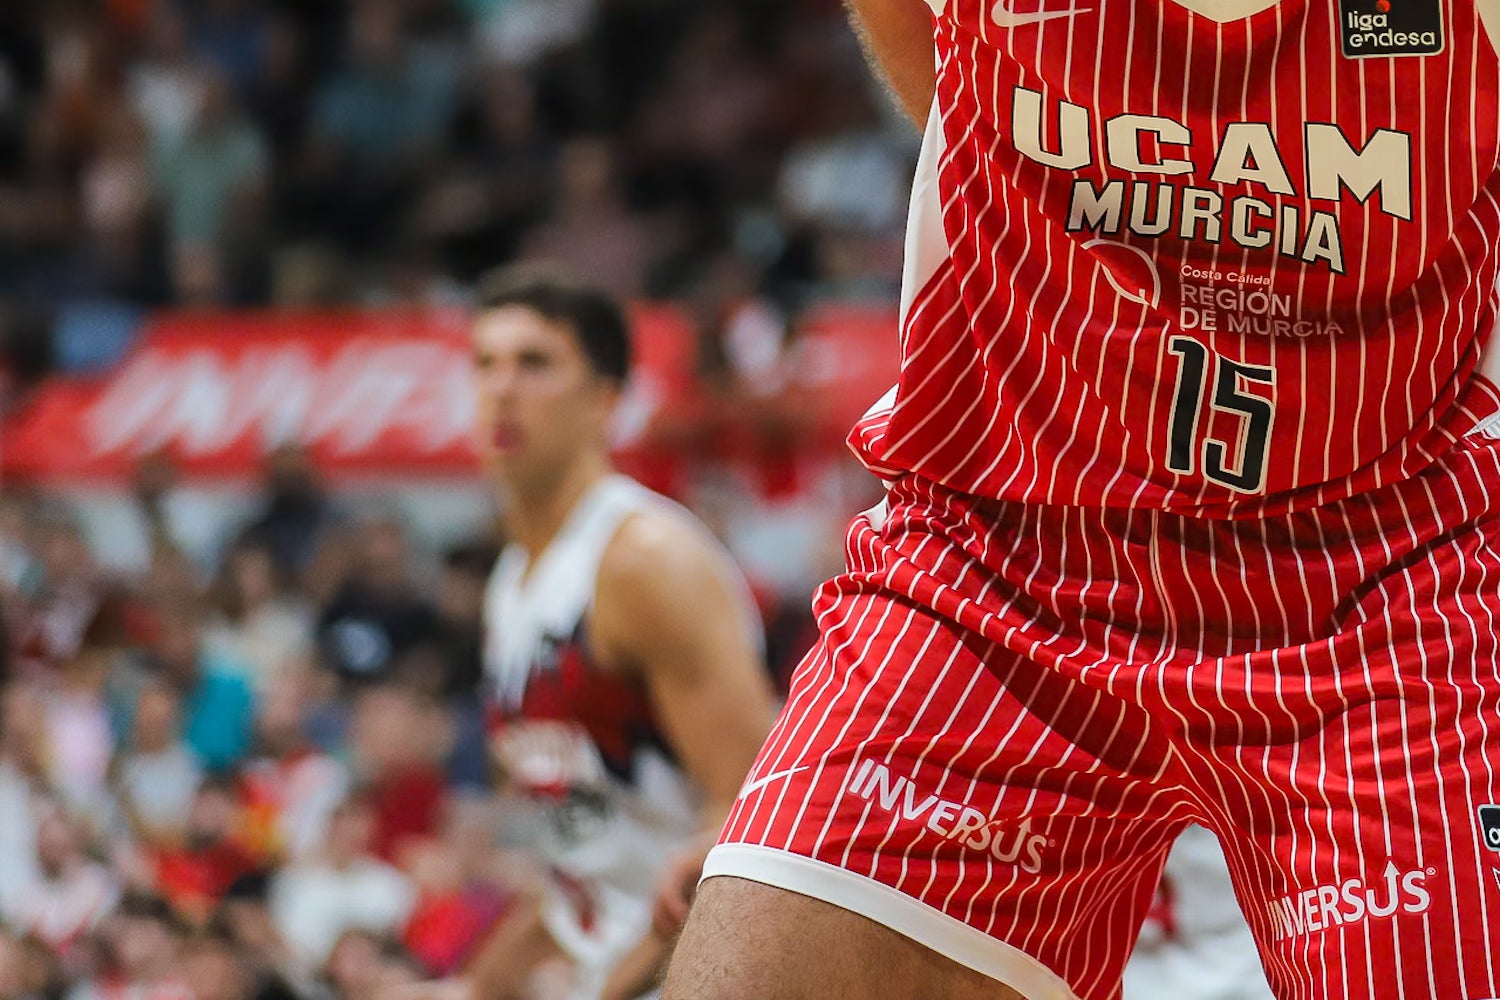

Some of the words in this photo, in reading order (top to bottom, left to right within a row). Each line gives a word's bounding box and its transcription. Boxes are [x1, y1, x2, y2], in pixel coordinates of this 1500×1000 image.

[1348, 10, 1387, 31] liga
[1349, 28, 1435, 47] endesa
[1012, 86, 1411, 221] UCAM
[1066, 179, 1345, 274] MURCIA
[1180, 264, 1222, 280] Costa
[1180, 284, 1291, 317] REGIÓN
[1180, 307, 1217, 331] DE
[1228, 313, 1344, 338] MURCIA
[1165, 335, 1277, 495] 15
[848, 757, 1047, 875] INVERSUS
